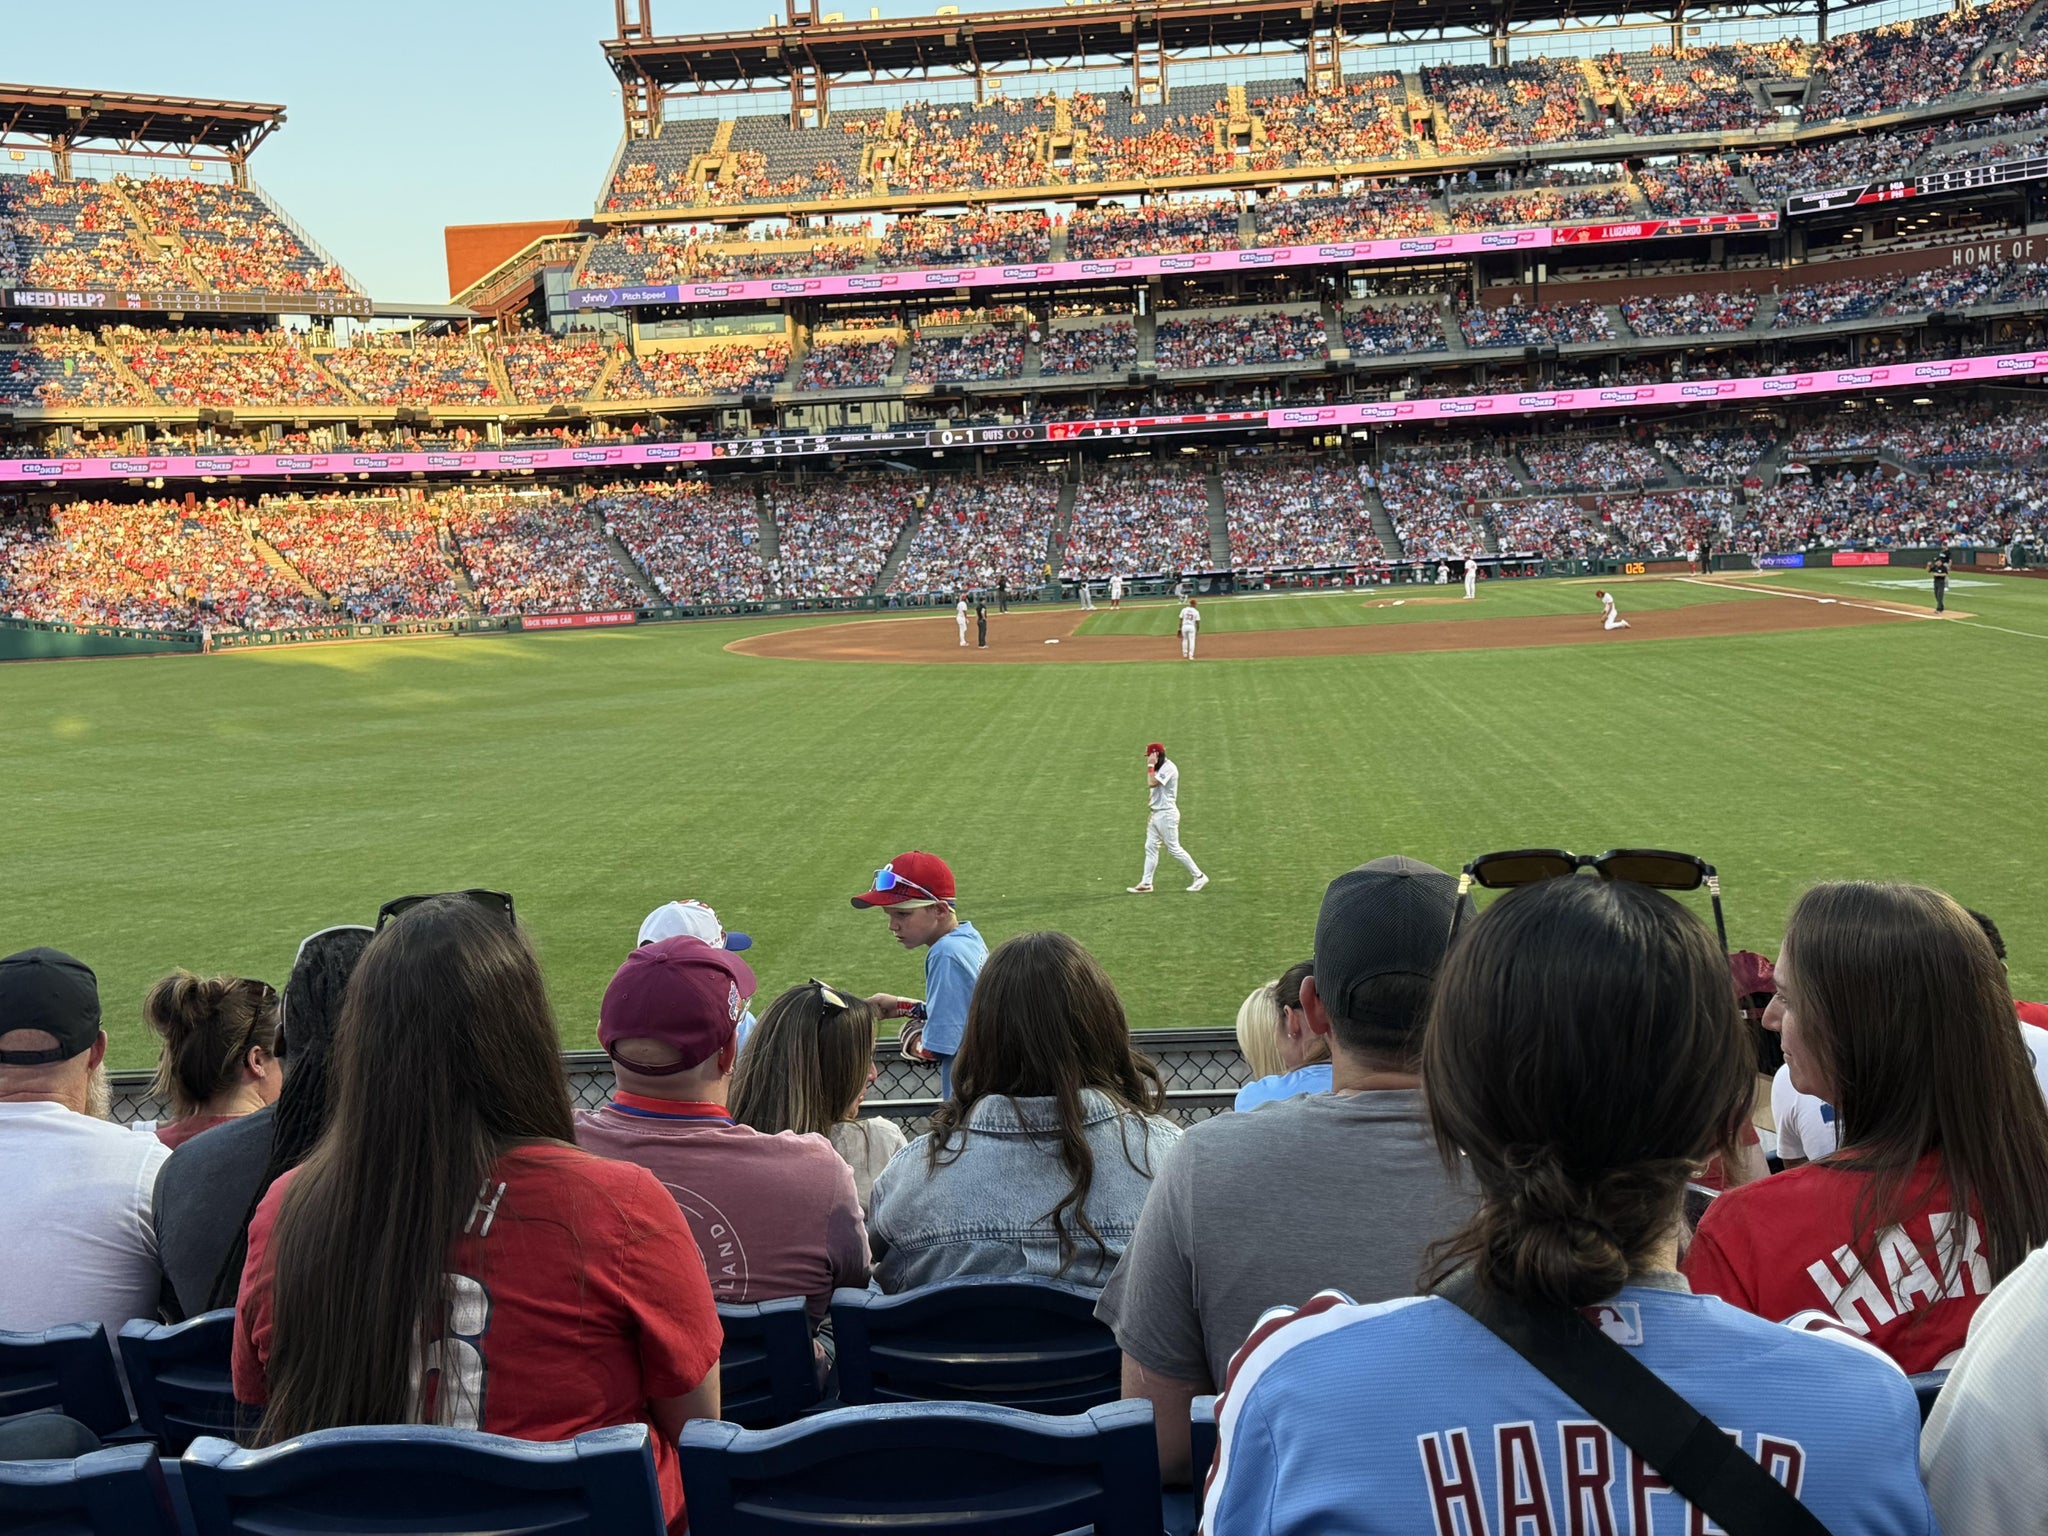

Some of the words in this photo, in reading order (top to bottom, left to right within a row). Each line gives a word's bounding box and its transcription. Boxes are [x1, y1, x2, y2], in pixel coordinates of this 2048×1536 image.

[1889, 182, 1904, 191] MIA
[1965, 170, 1971, 178] 0
[1989, 166, 1996, 174] 0
[1890, 190, 1904, 199] PHI
[1922, 185, 1929, 193] 3
[1609, 225, 1642, 238] LUZARDO
[1518, 233, 1534, 241] POP
[1436, 239, 1451, 248] POP
[1356, 245, 1370, 253] POP
[1953, 244, 2002, 265] HOME
[2013, 240, 2034, 259] OF
[1275, 251, 1289, 259] POP
[1196, 256, 1210, 264] POP
[1117, 262, 1131, 270] POP
[1038, 267, 1052, 275] POP
[883, 276, 897, 285] POP
[960, 272, 974, 280] POP
[729, 285, 743, 293] POP
[805, 281, 820, 289] POP
[14, 292, 56, 306] NEED
[58, 292, 106, 308] HELP?
[126, 293, 141, 301] MIA
[581, 293, 608, 304] xfinity
[622, 292, 641, 301] Pitch
[642, 291, 666, 301] Speed
[128, 301, 141, 309] PHI
[320, 301, 326, 309] R
[337, 302, 343, 310] H
[2036, 356, 2048, 365] PO
[1953, 363, 1969, 372] POP
[1873, 370, 1888, 380] POP
[1798, 377, 1812, 386] POP
[1719, 383, 1735, 392] POP
[1638, 389, 1653, 398] POP
[1556, 394, 1573, 404] POP
[1477, 400, 1492, 408] POP
[1398, 405, 1413, 413] POP
[1319, 410, 1334, 418] POP
[982, 430, 1003, 441] OUTS
[607, 449, 621, 458] POP
[681, 446, 695, 454] POP
[775, 446, 782, 454] 0
[233, 459, 249, 468] POP
[312, 458, 327, 466] POP
[387, 457, 402, 465] POP
[461, 456, 475, 464] POP
[62, 462, 80, 472] POP
[149, 461, 166, 470] POP
[1760, 558, 1775, 566] nity
[1776, 556, 1800, 564] mobile
[1625, 562, 1645, 575] 026
[542, 618, 558, 626] YOUR
[710, 1223, 737, 1300] LAND
[1806, 1211, 1992, 1336] HAR
[1417, 1419, 1807, 1536] HARPR
